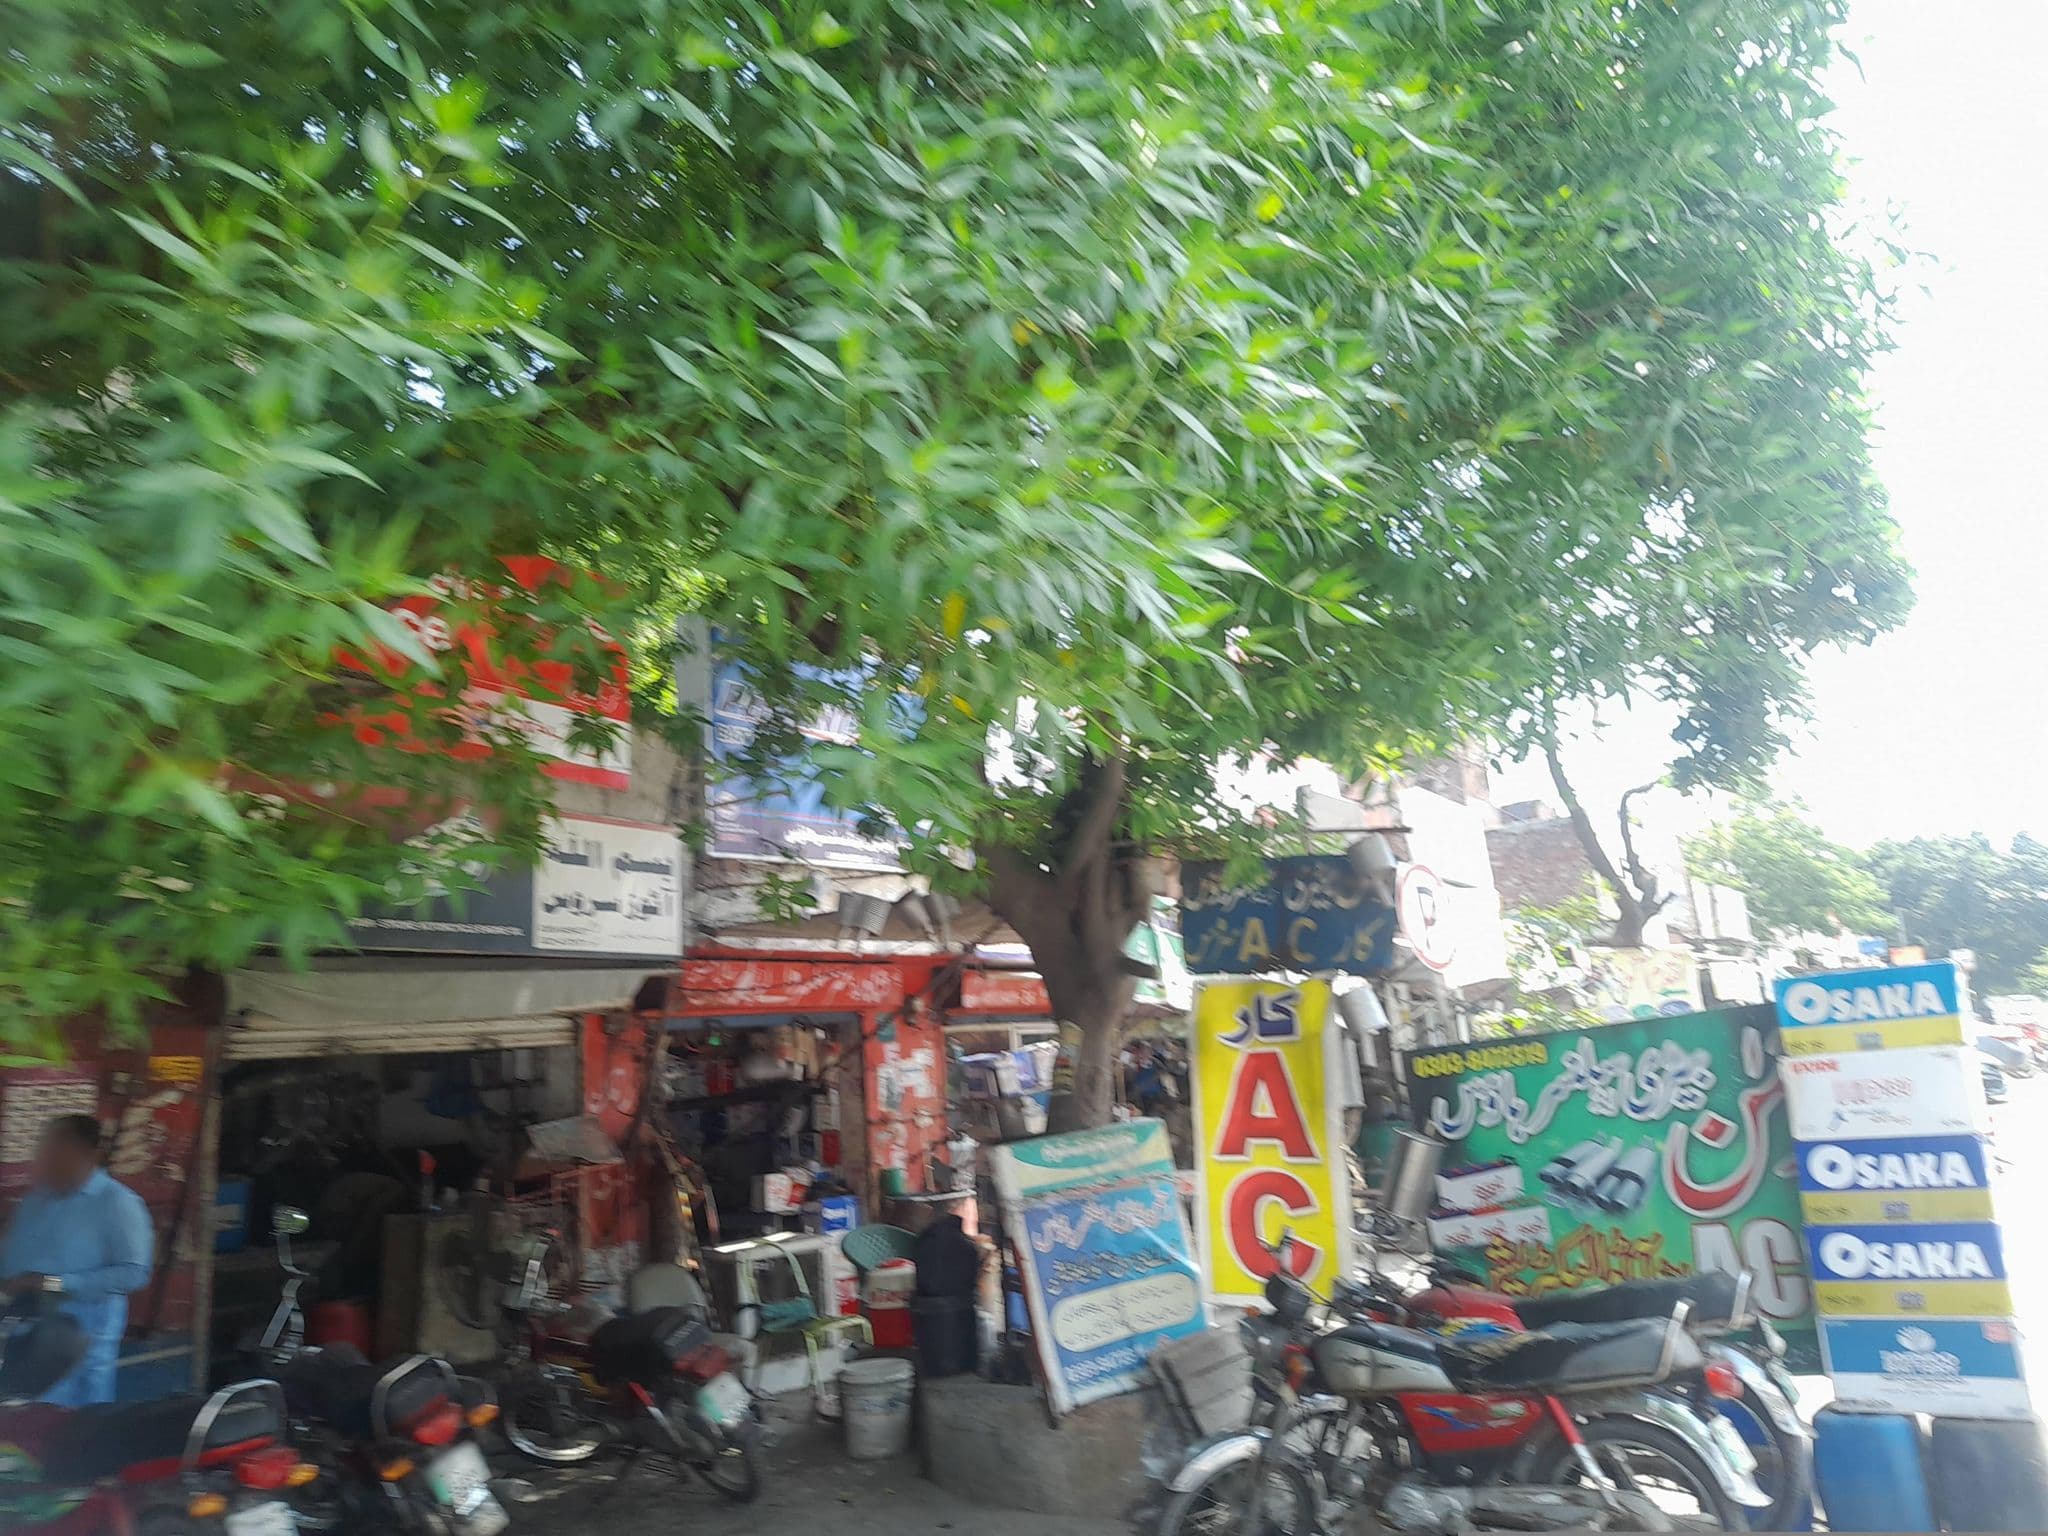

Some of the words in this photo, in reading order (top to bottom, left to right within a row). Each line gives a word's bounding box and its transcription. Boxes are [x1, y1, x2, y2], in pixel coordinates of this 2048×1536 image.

[1217, 992, 1298, 1048] کار
[1784, 980, 1948, 1025] OSAKA
[1806, 1143, 1978, 1190] OSAKA
[1819, 1231, 1995, 1279] OSAKA
